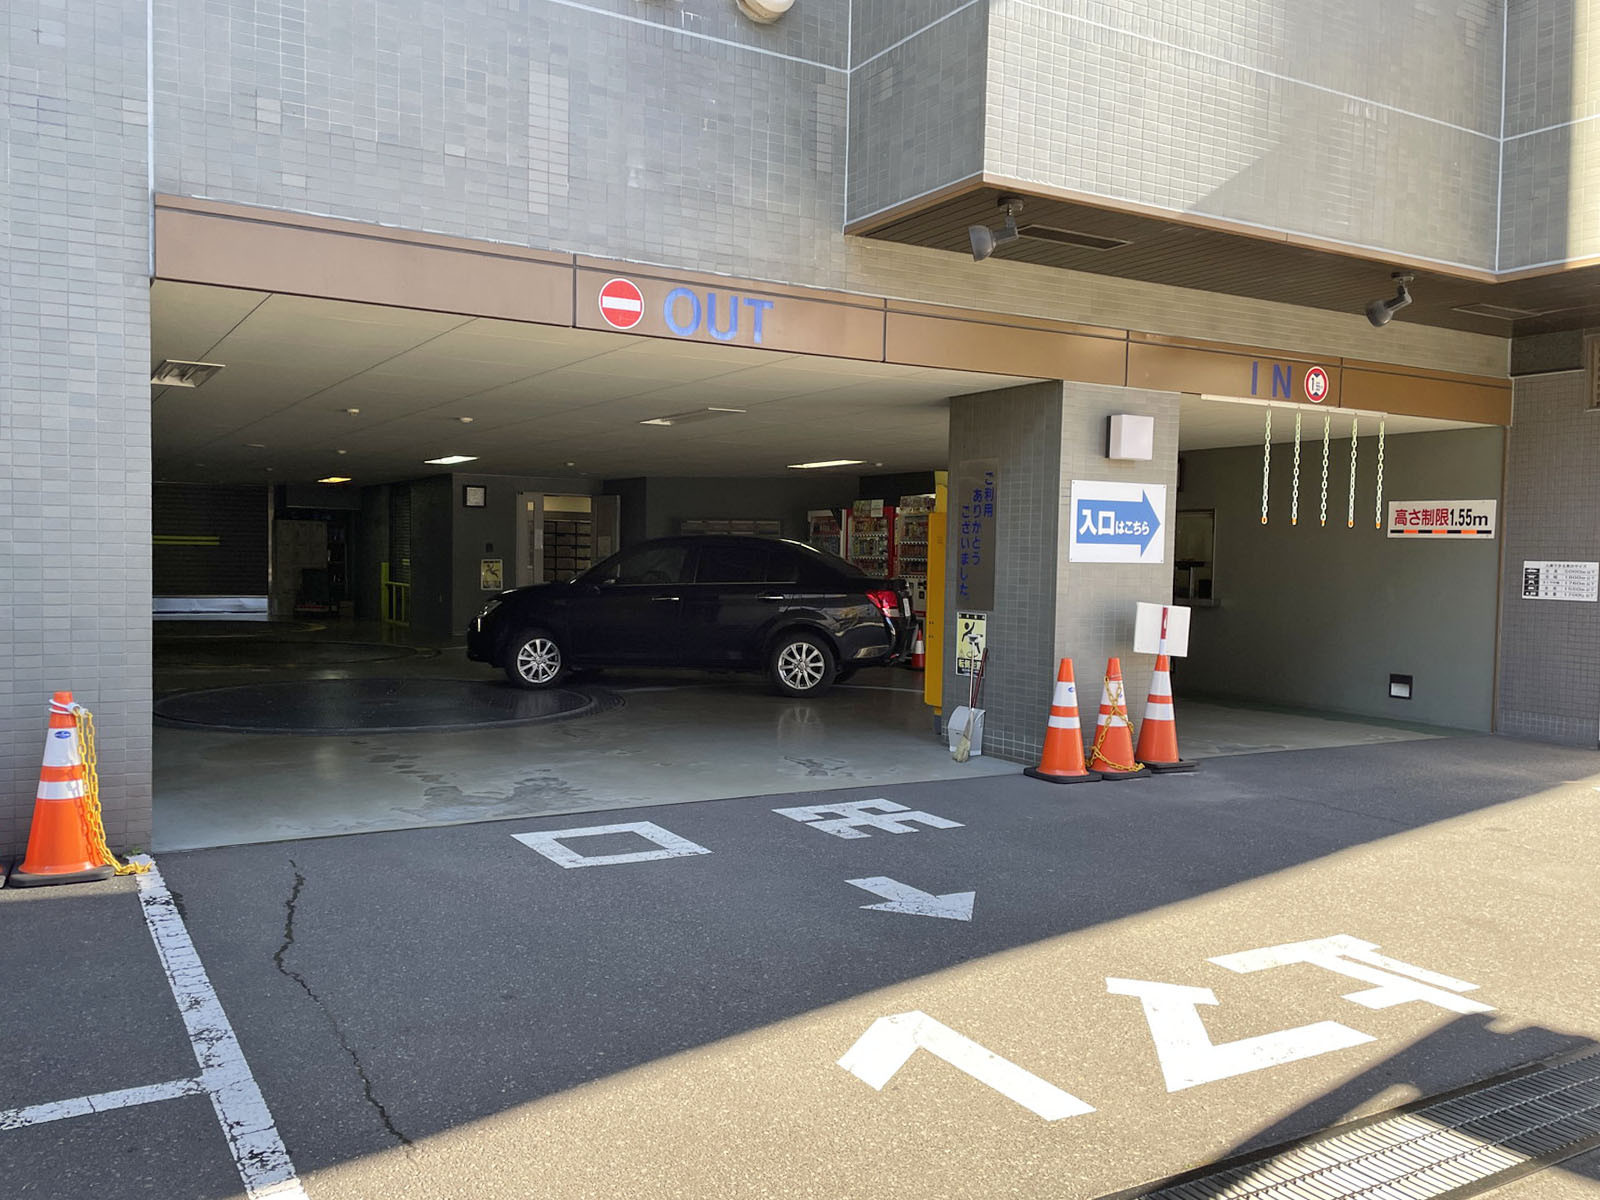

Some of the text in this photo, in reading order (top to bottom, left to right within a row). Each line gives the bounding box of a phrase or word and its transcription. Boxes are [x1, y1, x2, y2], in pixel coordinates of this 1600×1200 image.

[664, 287, 774, 344] OUT
[1251, 361, 1292, 399] IN
[1079, 508, 1150, 536] 入口はこちら
[511, 798, 963, 870] 出口
